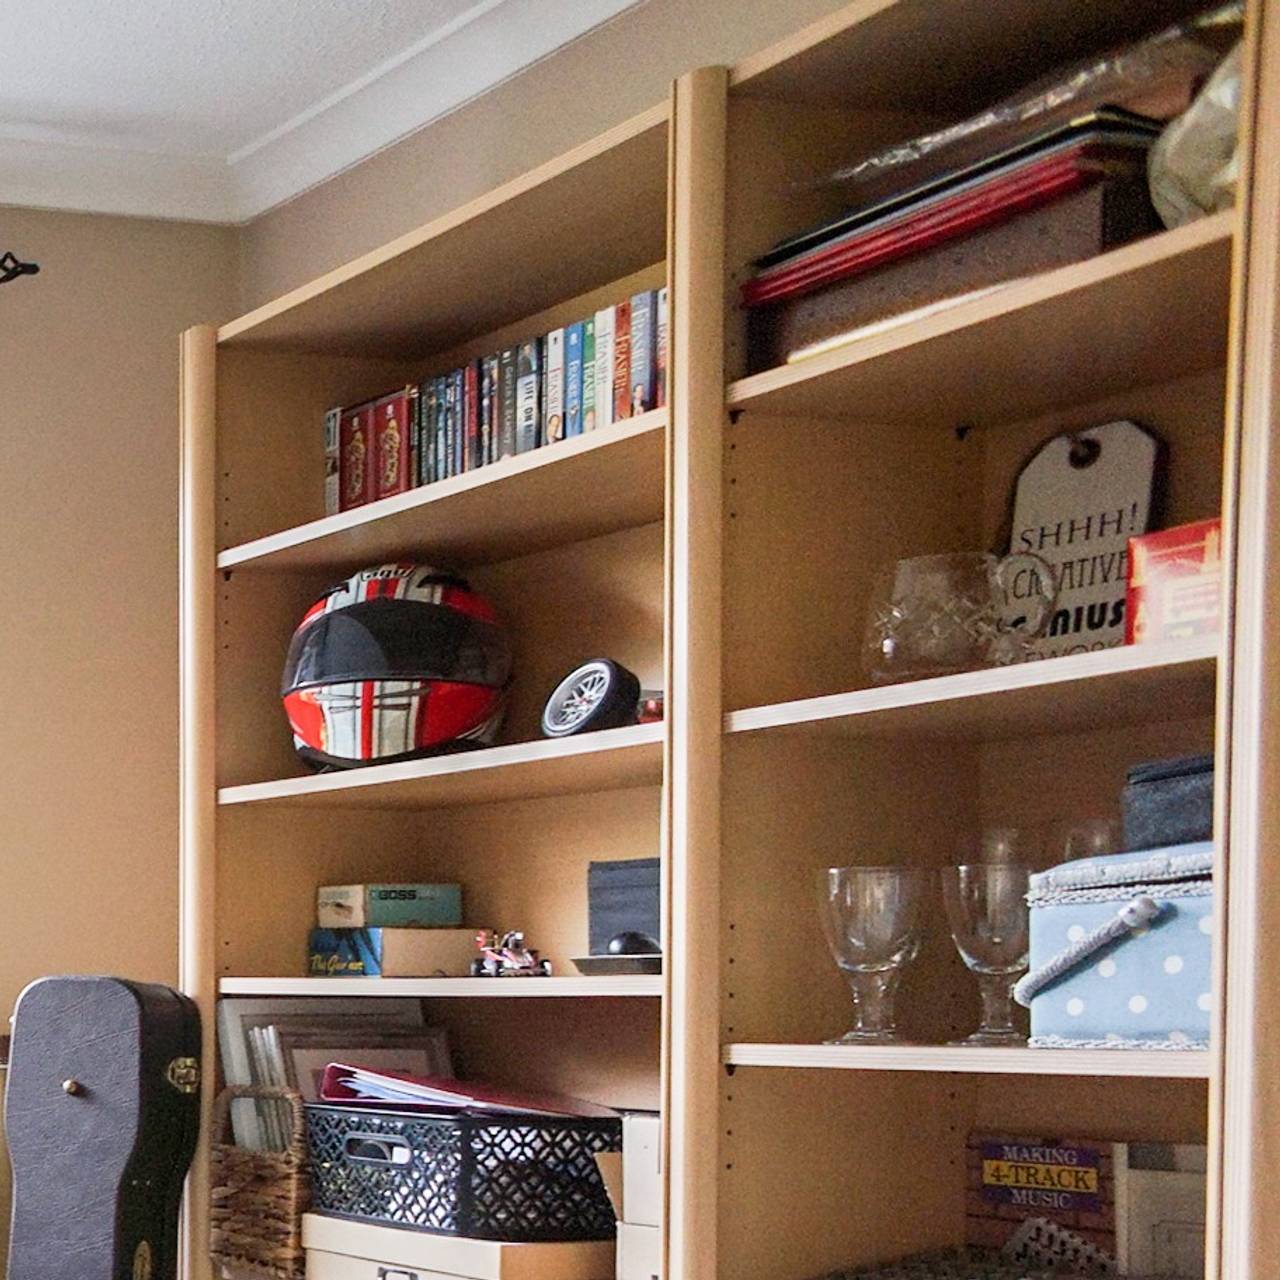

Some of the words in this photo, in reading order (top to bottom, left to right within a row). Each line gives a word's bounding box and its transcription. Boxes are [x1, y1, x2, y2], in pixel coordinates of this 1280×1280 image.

[615, 334, 631, 394] FRASIER
[523, 406, 534, 423] ON
[1020, 502, 1138, 550] SHHH!
[1012, 550, 1127, 600] CRATIVE
[1000, 598, 1126, 638] NIUS
[378, 889, 417, 901] BOSS
[1002, 1145, 1077, 1165] MAKING
[990, 1162, 1090, 1190] 4-TRACK
[1011, 1188, 1072, 1209] MUSIC
